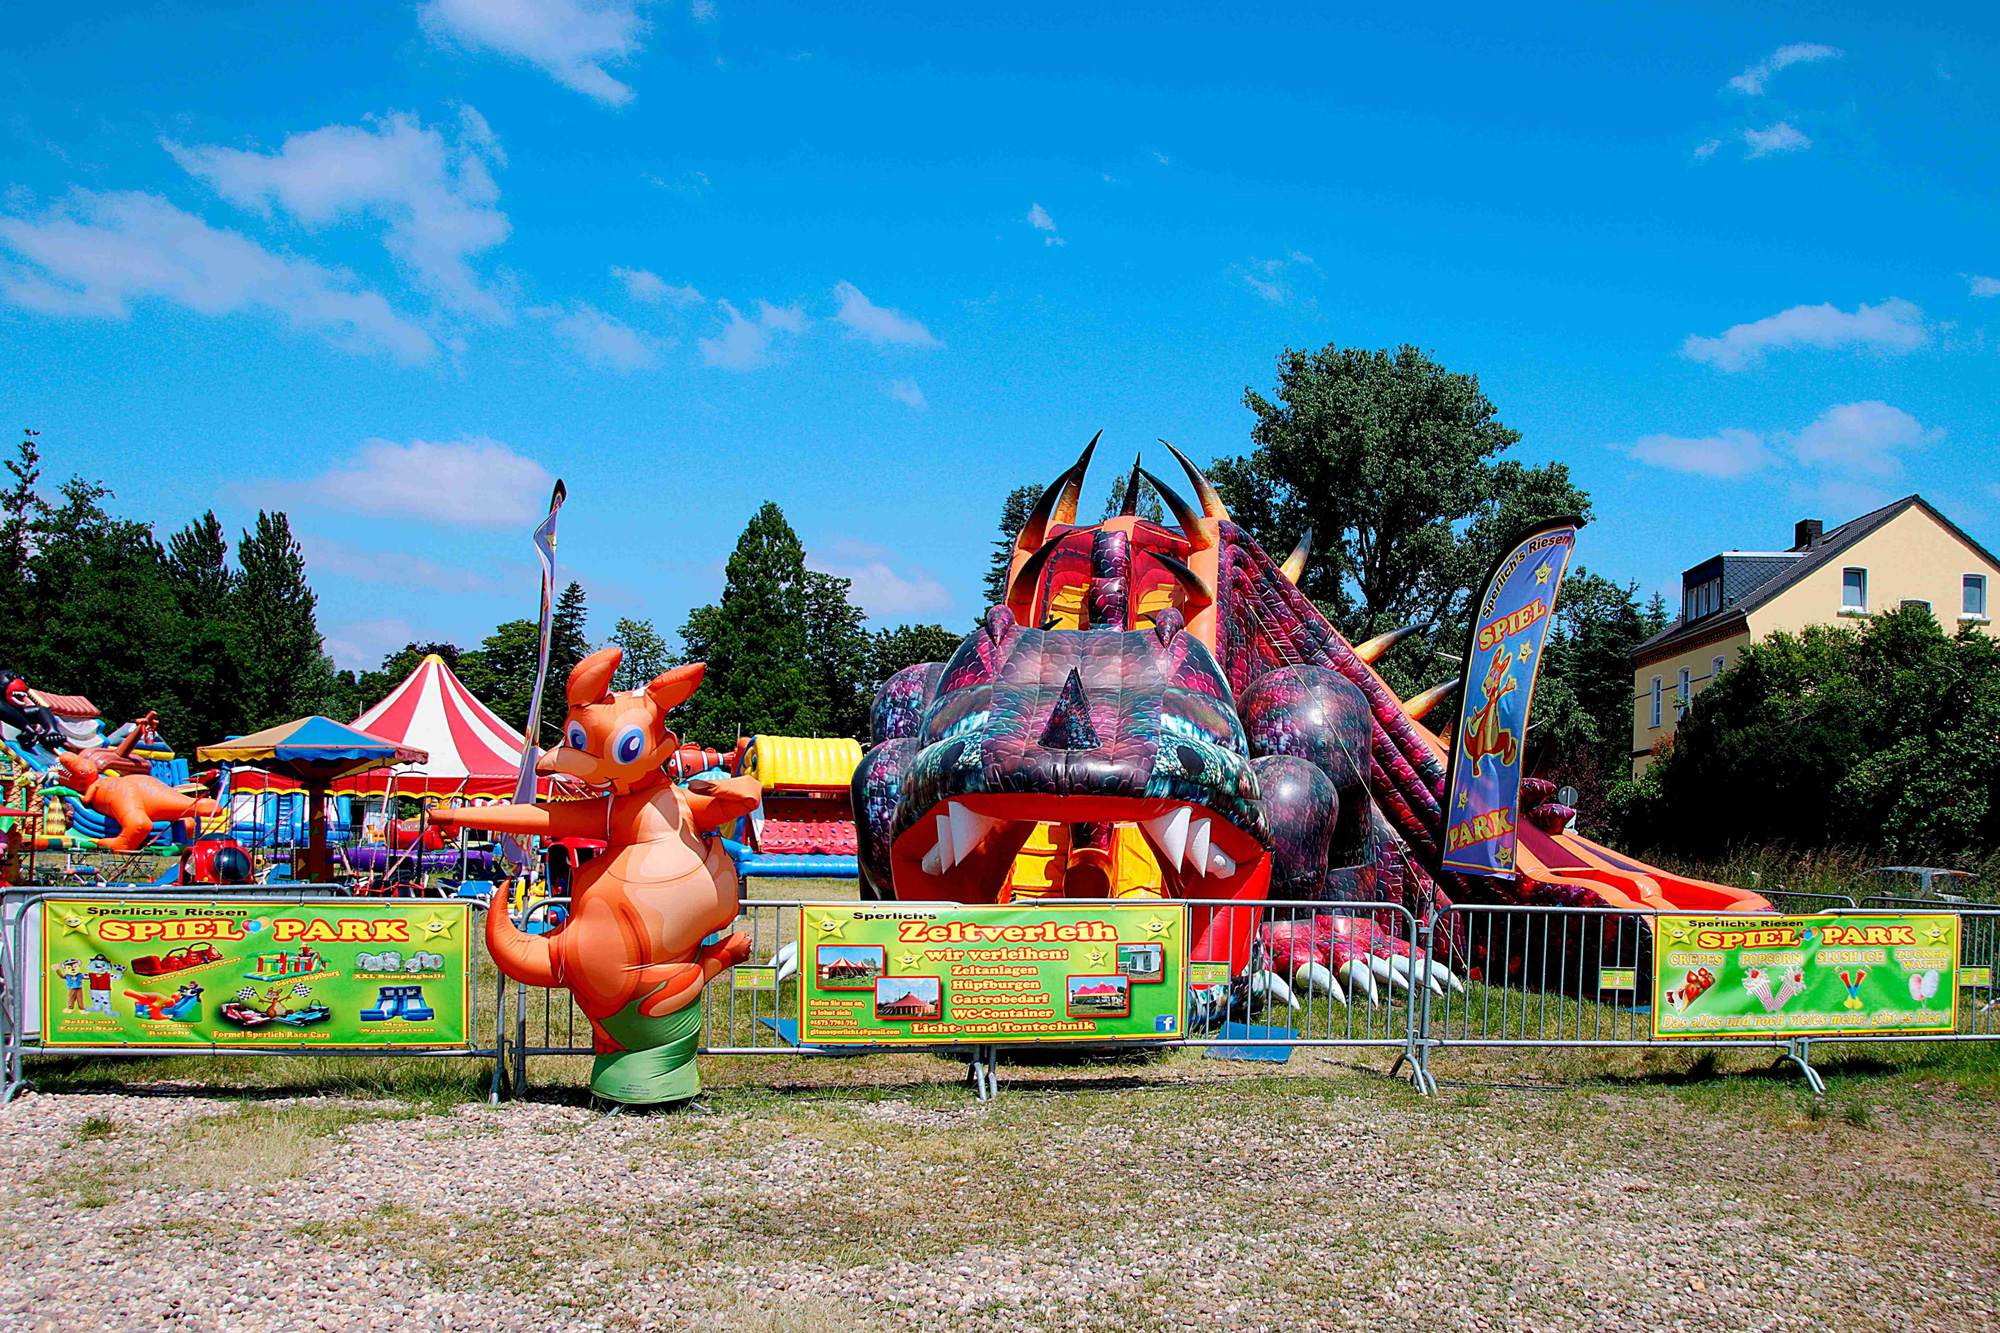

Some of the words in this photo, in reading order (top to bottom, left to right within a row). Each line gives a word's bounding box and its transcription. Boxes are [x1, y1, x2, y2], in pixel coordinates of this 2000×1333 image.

[1482, 551, 1526, 619] Sperlich's
[1528, 535, 1571, 555] Riesen
[1478, 598, 1547, 651] SPIEL
[1448, 807, 1515, 854] PARK
[185, 908, 248, 916] Riesen
[99, 918, 246, 942] SPIEL
[273, 918, 410, 942] PARK
[898, 921, 1118, 943] Zeltverleih
[1698, 929, 1801, 950] SPIEL
[1821, 926, 1916, 946] PARK
[924, 947, 965, 962] wir
[966, 946, 1069, 961] verleihen:
[1669, 953, 1723, 966] CREPES
[1740, 953, 1803, 966] POPCORN
[1816, 951, 1860, 963] SLUSH
[1860, 951, 1885, 963] ICE
[1895, 949, 1952, 960] ZUCKER-
[951, 965, 1039, 977] Zeltanlagen
[1902, 960, 1946, 970] WATTE
[274, 977, 302, 987] Gorilla
[302, 970, 341, 982] Hüpfburg
[951, 979, 1041, 992] Hüpfburgen
[809, 999, 829, 1007] Rufen
[830, 999, 840, 1007] Sie
[853, 1000, 865, 1008] an,
[951, 993, 1050, 1005] Gastrobedarf
[951, 1009, 1055, 1020] WC-Container
[1662, 1014, 1687, 1028] Das
[1690, 1014, 1722, 1028] alles
[1725, 1014, 1751, 1027] und
[1753, 1013, 1785, 1027] noch
[1789, 1012, 1827, 1025] vieles
[1830, 1011, 1867, 1026] mehr,
[1869, 1010, 1897, 1027] gibt
[1900, 1014, 1914, 1024] es
[1915, 1010, 1940, 1023] hier
[911, 1023, 962, 1034] Licht-
[965, 1022, 999, 1033] und
[1000, 1021, 1096, 1032] Tontechnik
[212, 1030, 245, 1039] Formel
[246, 1030, 285, 1039] Sperlich
[286, 1030, 308, 1039] Race
[309, 1030, 331, 1039] Cars
